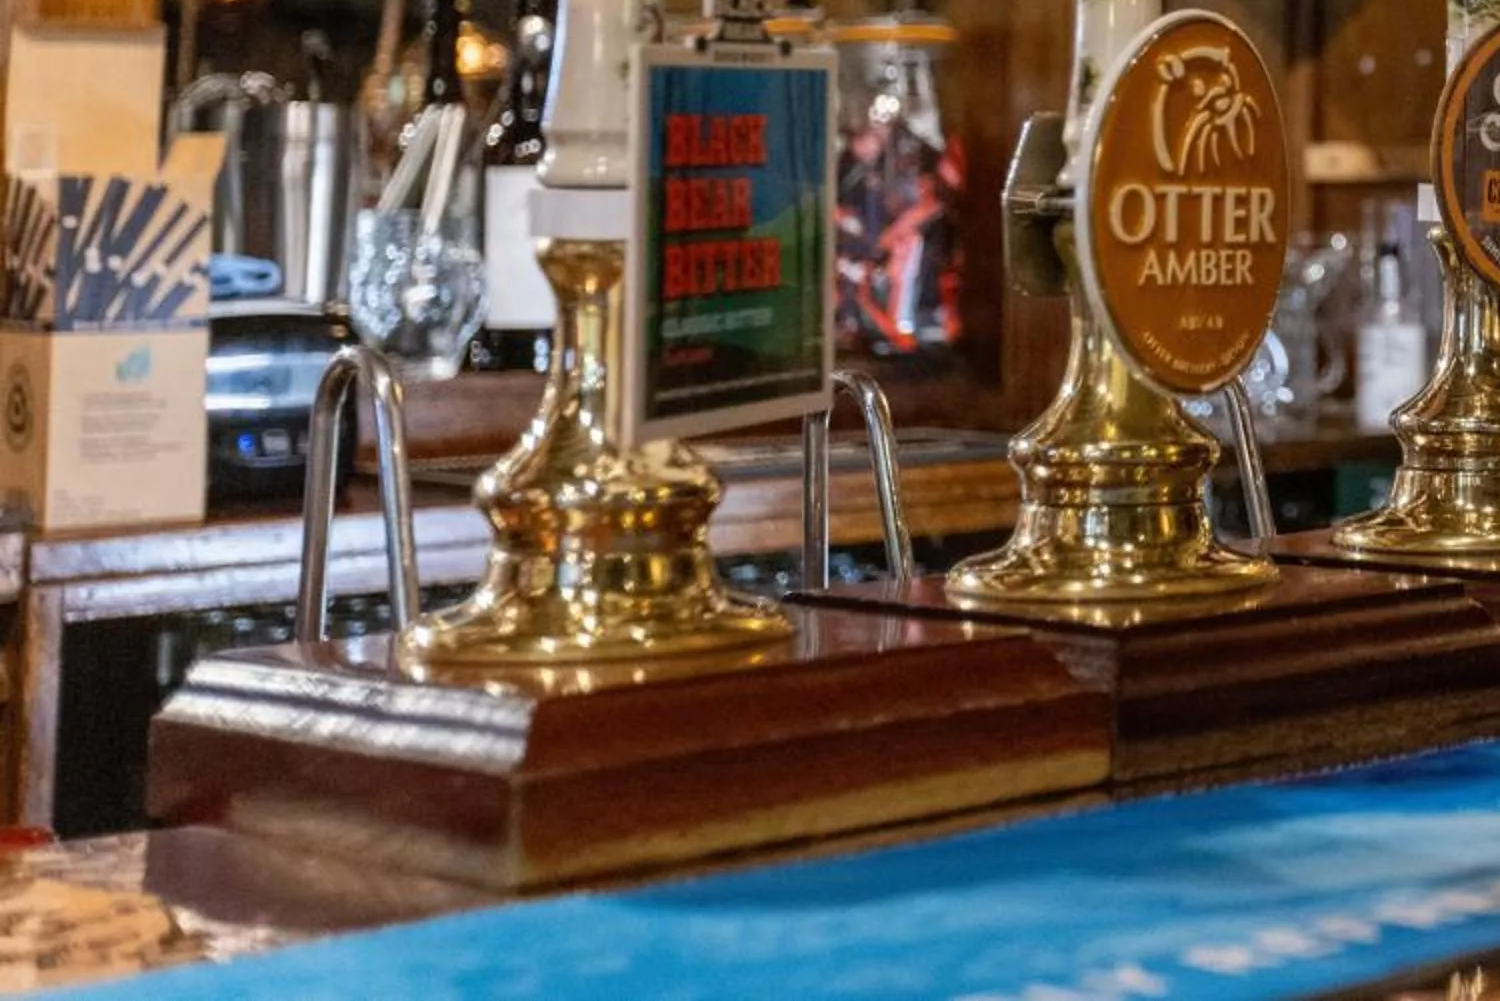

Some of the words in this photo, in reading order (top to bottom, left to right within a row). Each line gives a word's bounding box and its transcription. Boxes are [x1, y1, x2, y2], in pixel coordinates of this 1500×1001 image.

[666, 114, 768, 166] BLACK
[665, 177, 753, 233] BEAR
[1109, 183, 1277, 245] OTTER
[663, 237, 782, 302] BITTER
[1138, 249, 1254, 286] AMBER
